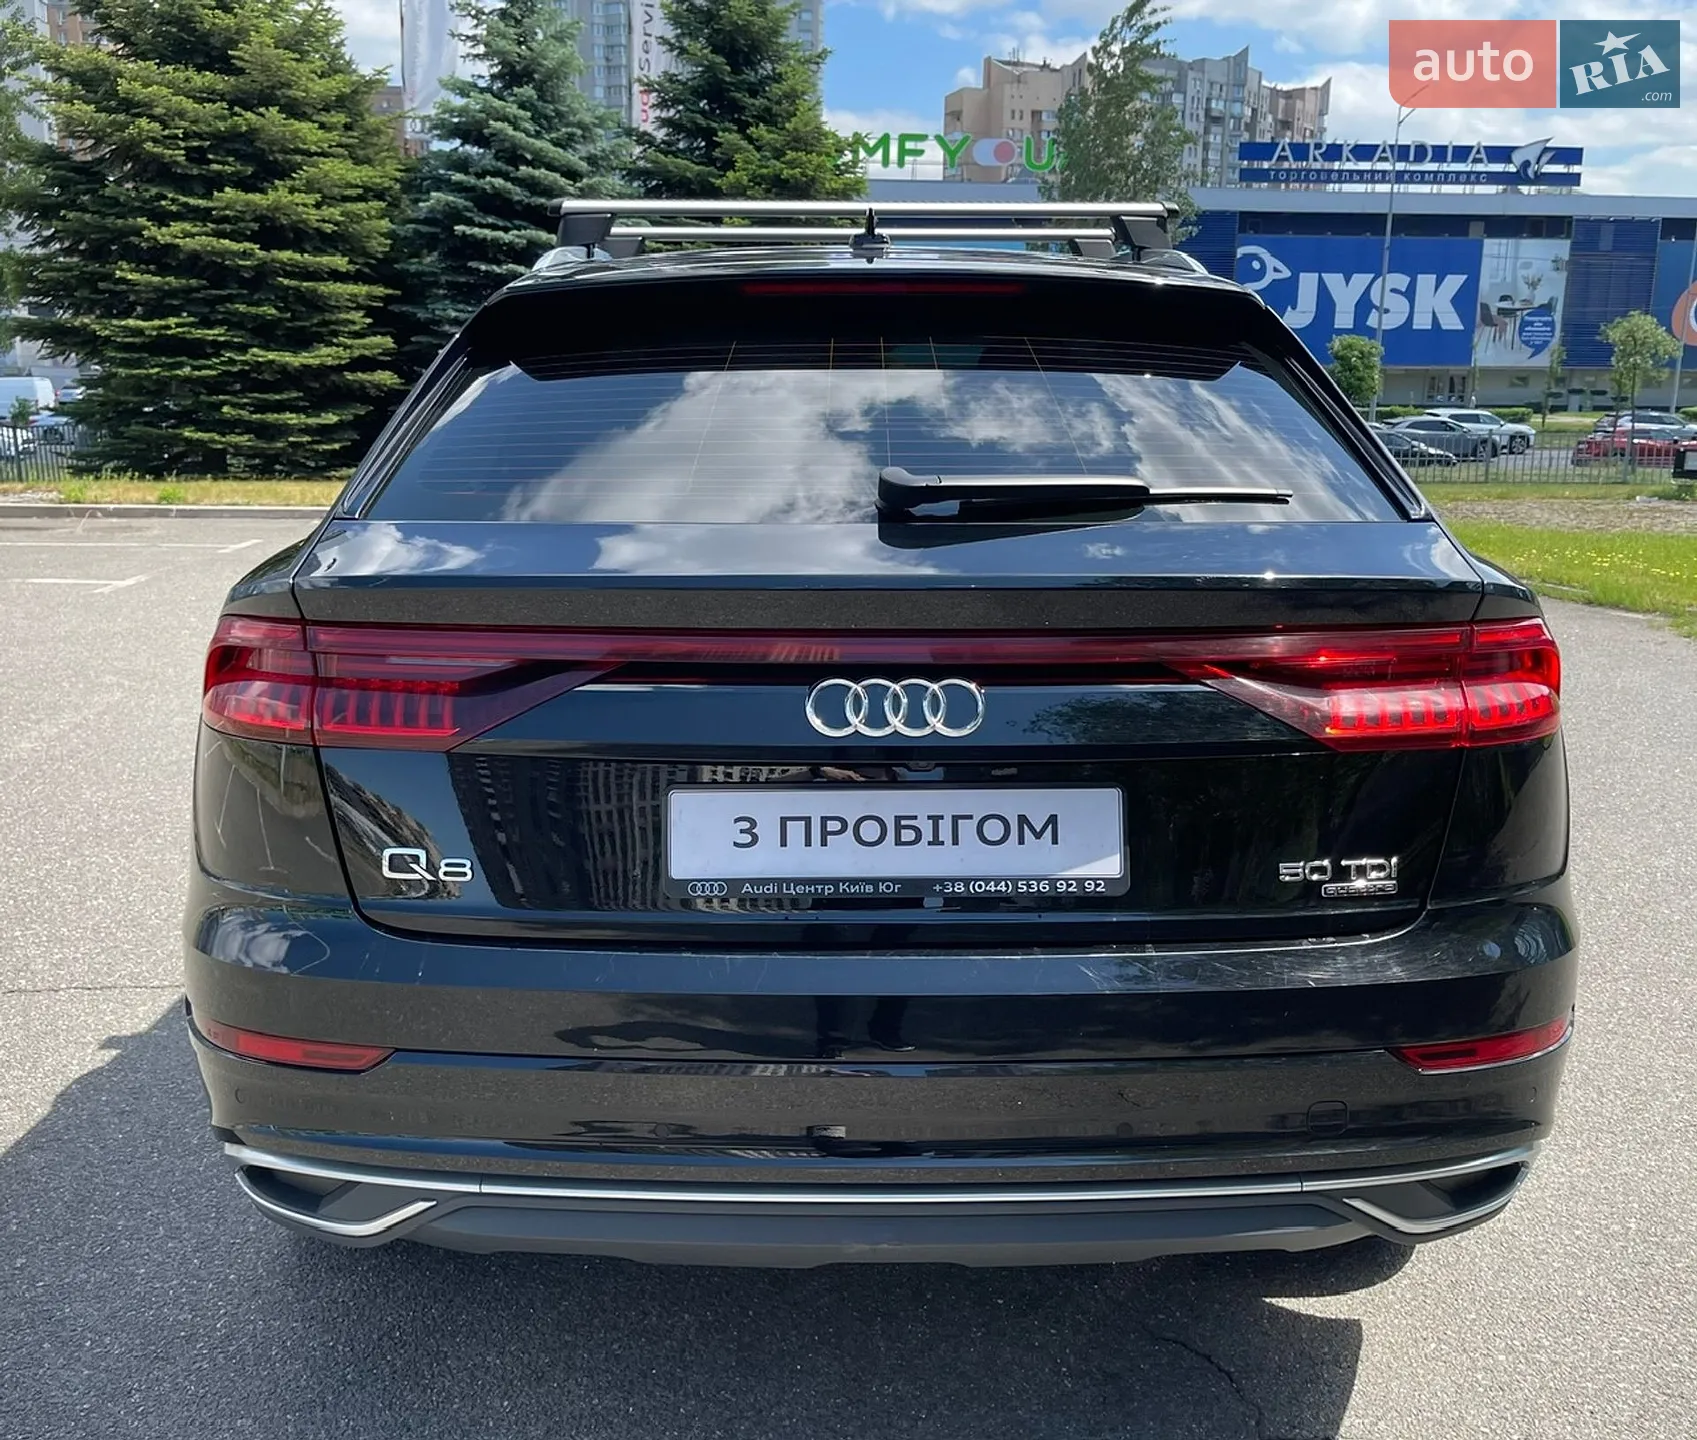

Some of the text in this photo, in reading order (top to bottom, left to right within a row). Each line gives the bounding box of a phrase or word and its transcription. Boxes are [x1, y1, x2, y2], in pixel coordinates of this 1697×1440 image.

[1270, 138, 1489, 168] ARKADIA
[1403, 172, 1488, 182] комплекс
[1284, 272, 1468, 330] JYSK
[779, 814, 1058, 848] ПРОБІГОМ
[382, 847, 473, 882] Q8
[1279, 856, 1399, 882] 50 TDI
[741, 882, 902, 896] Audi Центр Київ Юг
[933, 880, 1106, 893] +38 (044) 536 92 92
